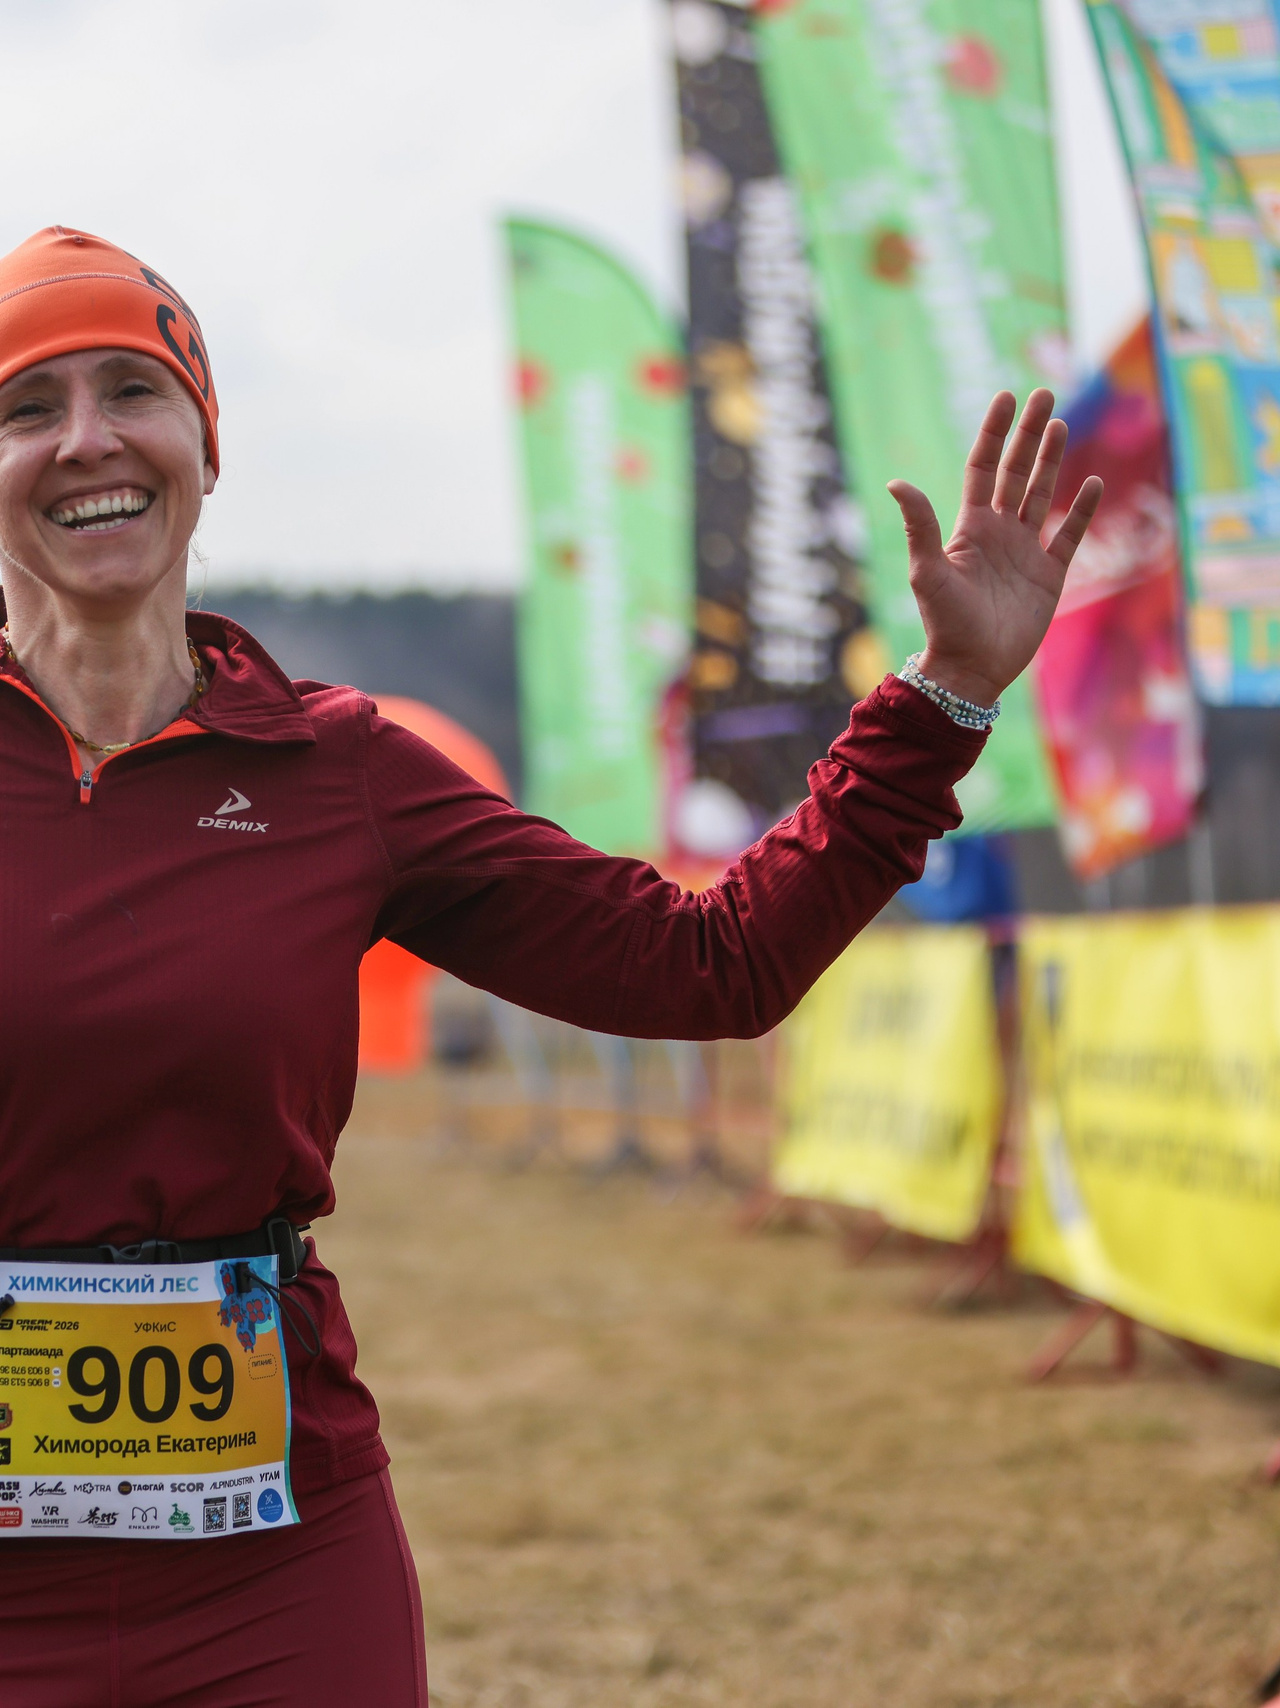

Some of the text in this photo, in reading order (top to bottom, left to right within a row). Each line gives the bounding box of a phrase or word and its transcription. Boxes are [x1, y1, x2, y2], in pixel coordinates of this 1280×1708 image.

[197, 816, 270, 833] DEMIX
[8, 1274, 199, 1293] ХИМКИНСКИЙ ЛЕС
[54, 1321, 79, 1331] 2026
[134, 1321, 177, 1333] УФКиС
[67, 1343, 235, 1424] 909
[33, 1430, 257, 1459] Химорода Екатерина
[132, 1482, 165, 1492] ТАФГАЙ
[170, 1482, 204, 1493] SCOR
